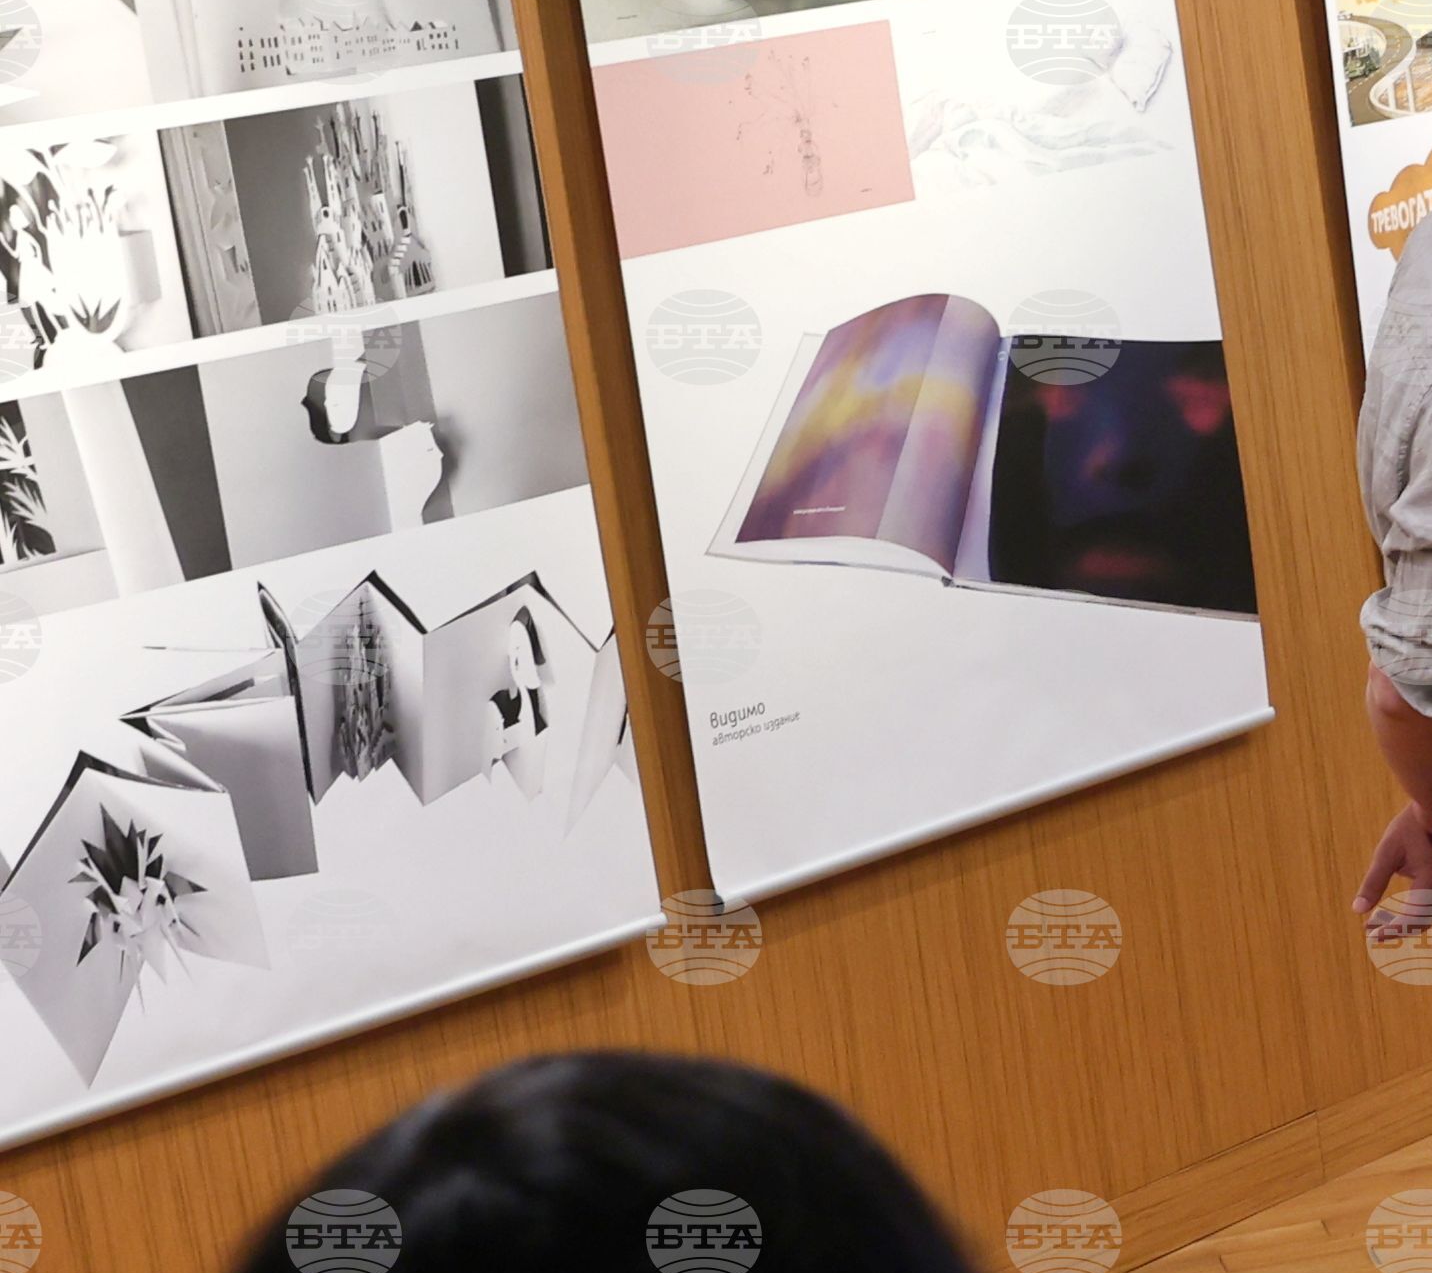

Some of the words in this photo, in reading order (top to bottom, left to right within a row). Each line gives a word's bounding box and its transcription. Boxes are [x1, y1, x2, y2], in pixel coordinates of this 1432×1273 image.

[710, 702, 766, 729] видимо
[712, 724, 761, 746] авторско
[763, 711, 801, 732] издание
